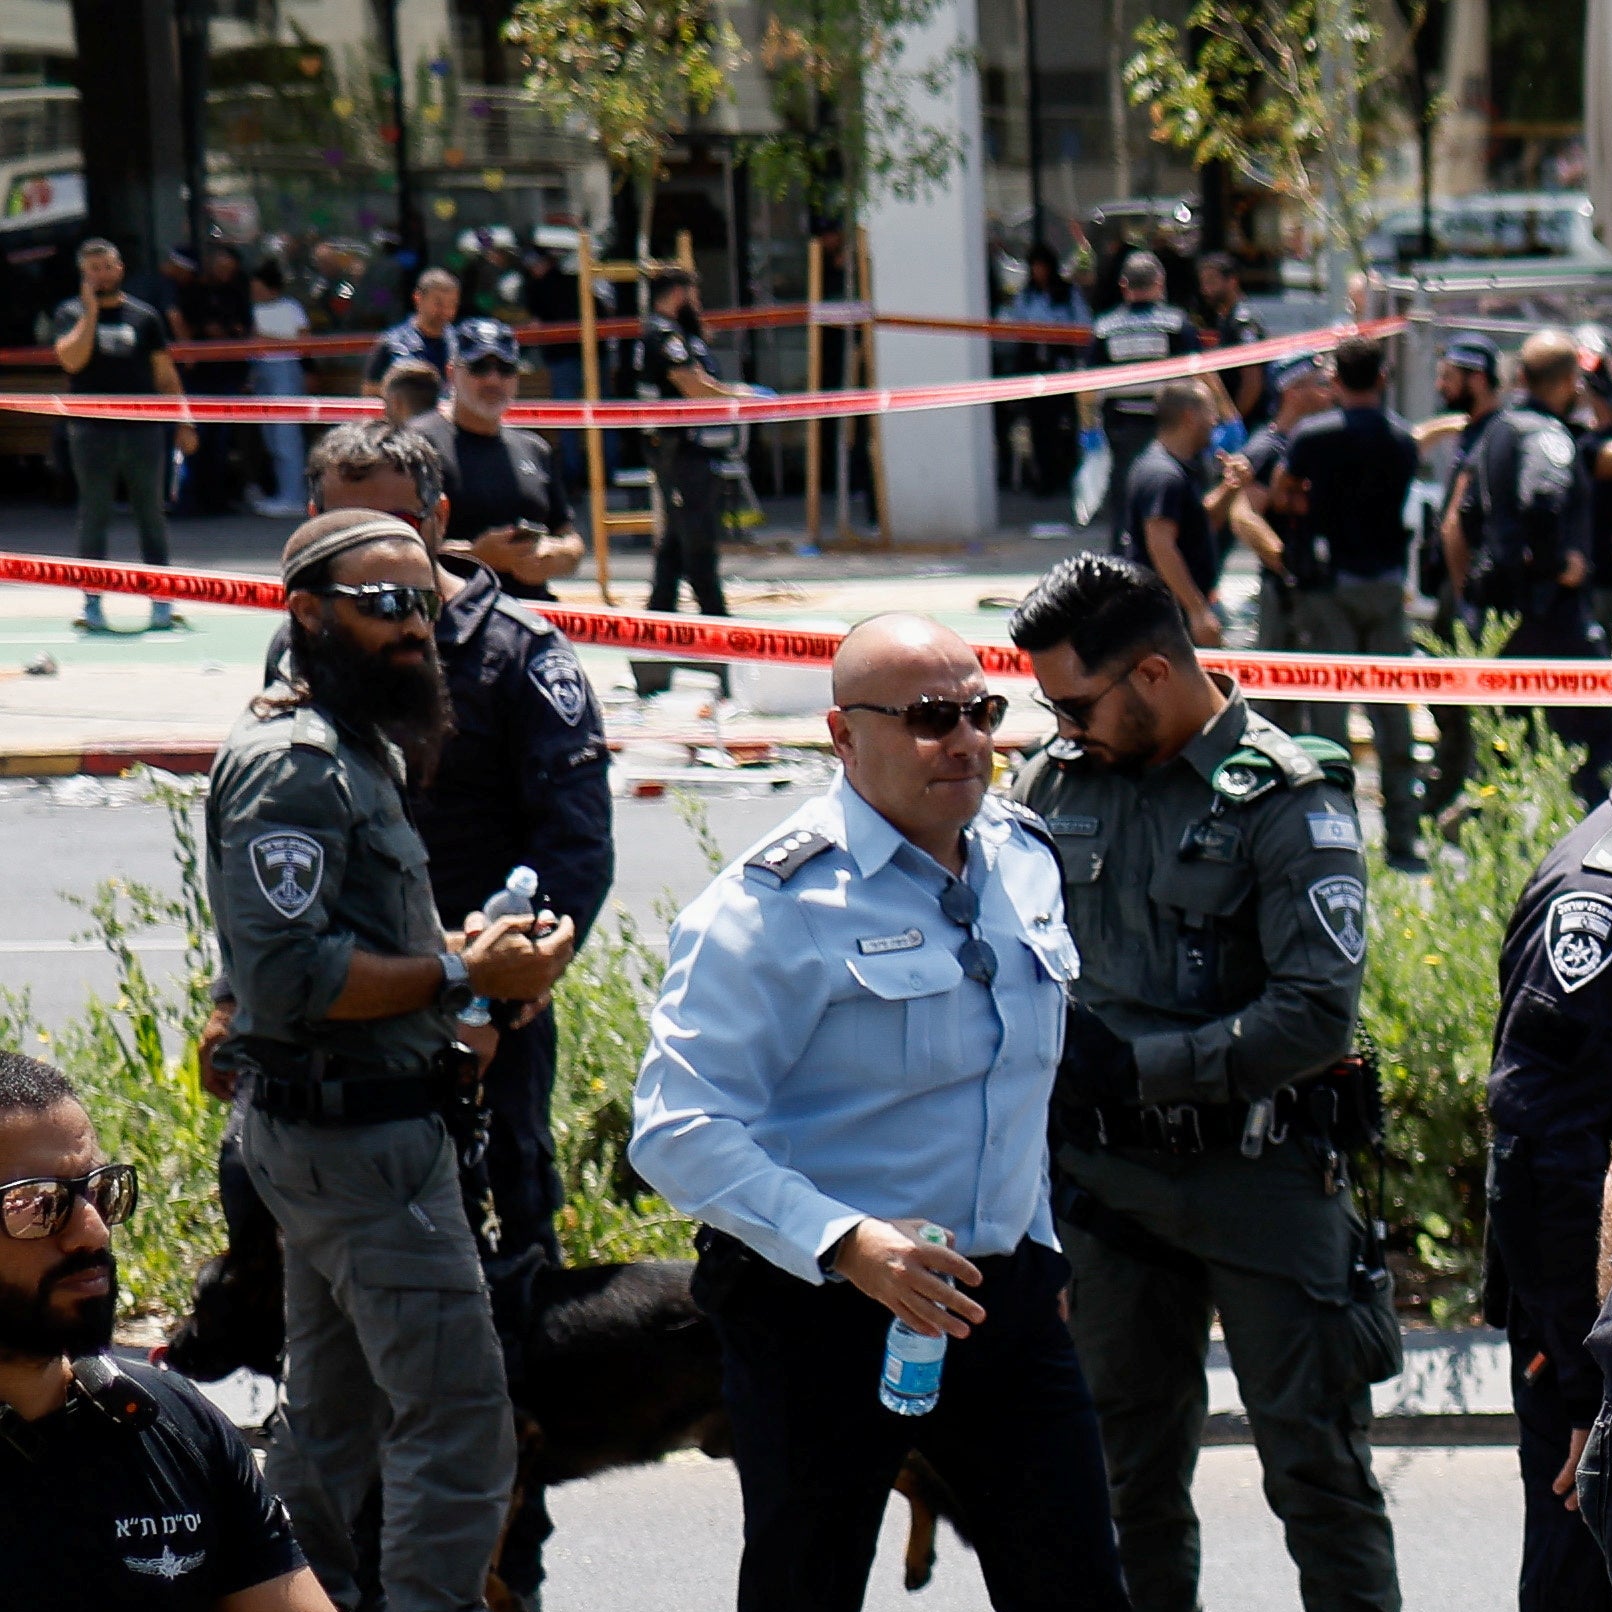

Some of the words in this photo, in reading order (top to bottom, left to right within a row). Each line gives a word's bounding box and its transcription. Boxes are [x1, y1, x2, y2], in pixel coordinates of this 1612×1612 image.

[589, 613, 621, 641] אין
[1270, 666, 1329, 687] מעבר
[1336, 666, 1368, 691] אין
[1370, 665, 1454, 688] ישראל
[1509, 673, 1597, 691] משטרת
[115, 1517, 158, 1538] ת"א
[161, 1513, 202, 1534] יס"מ
